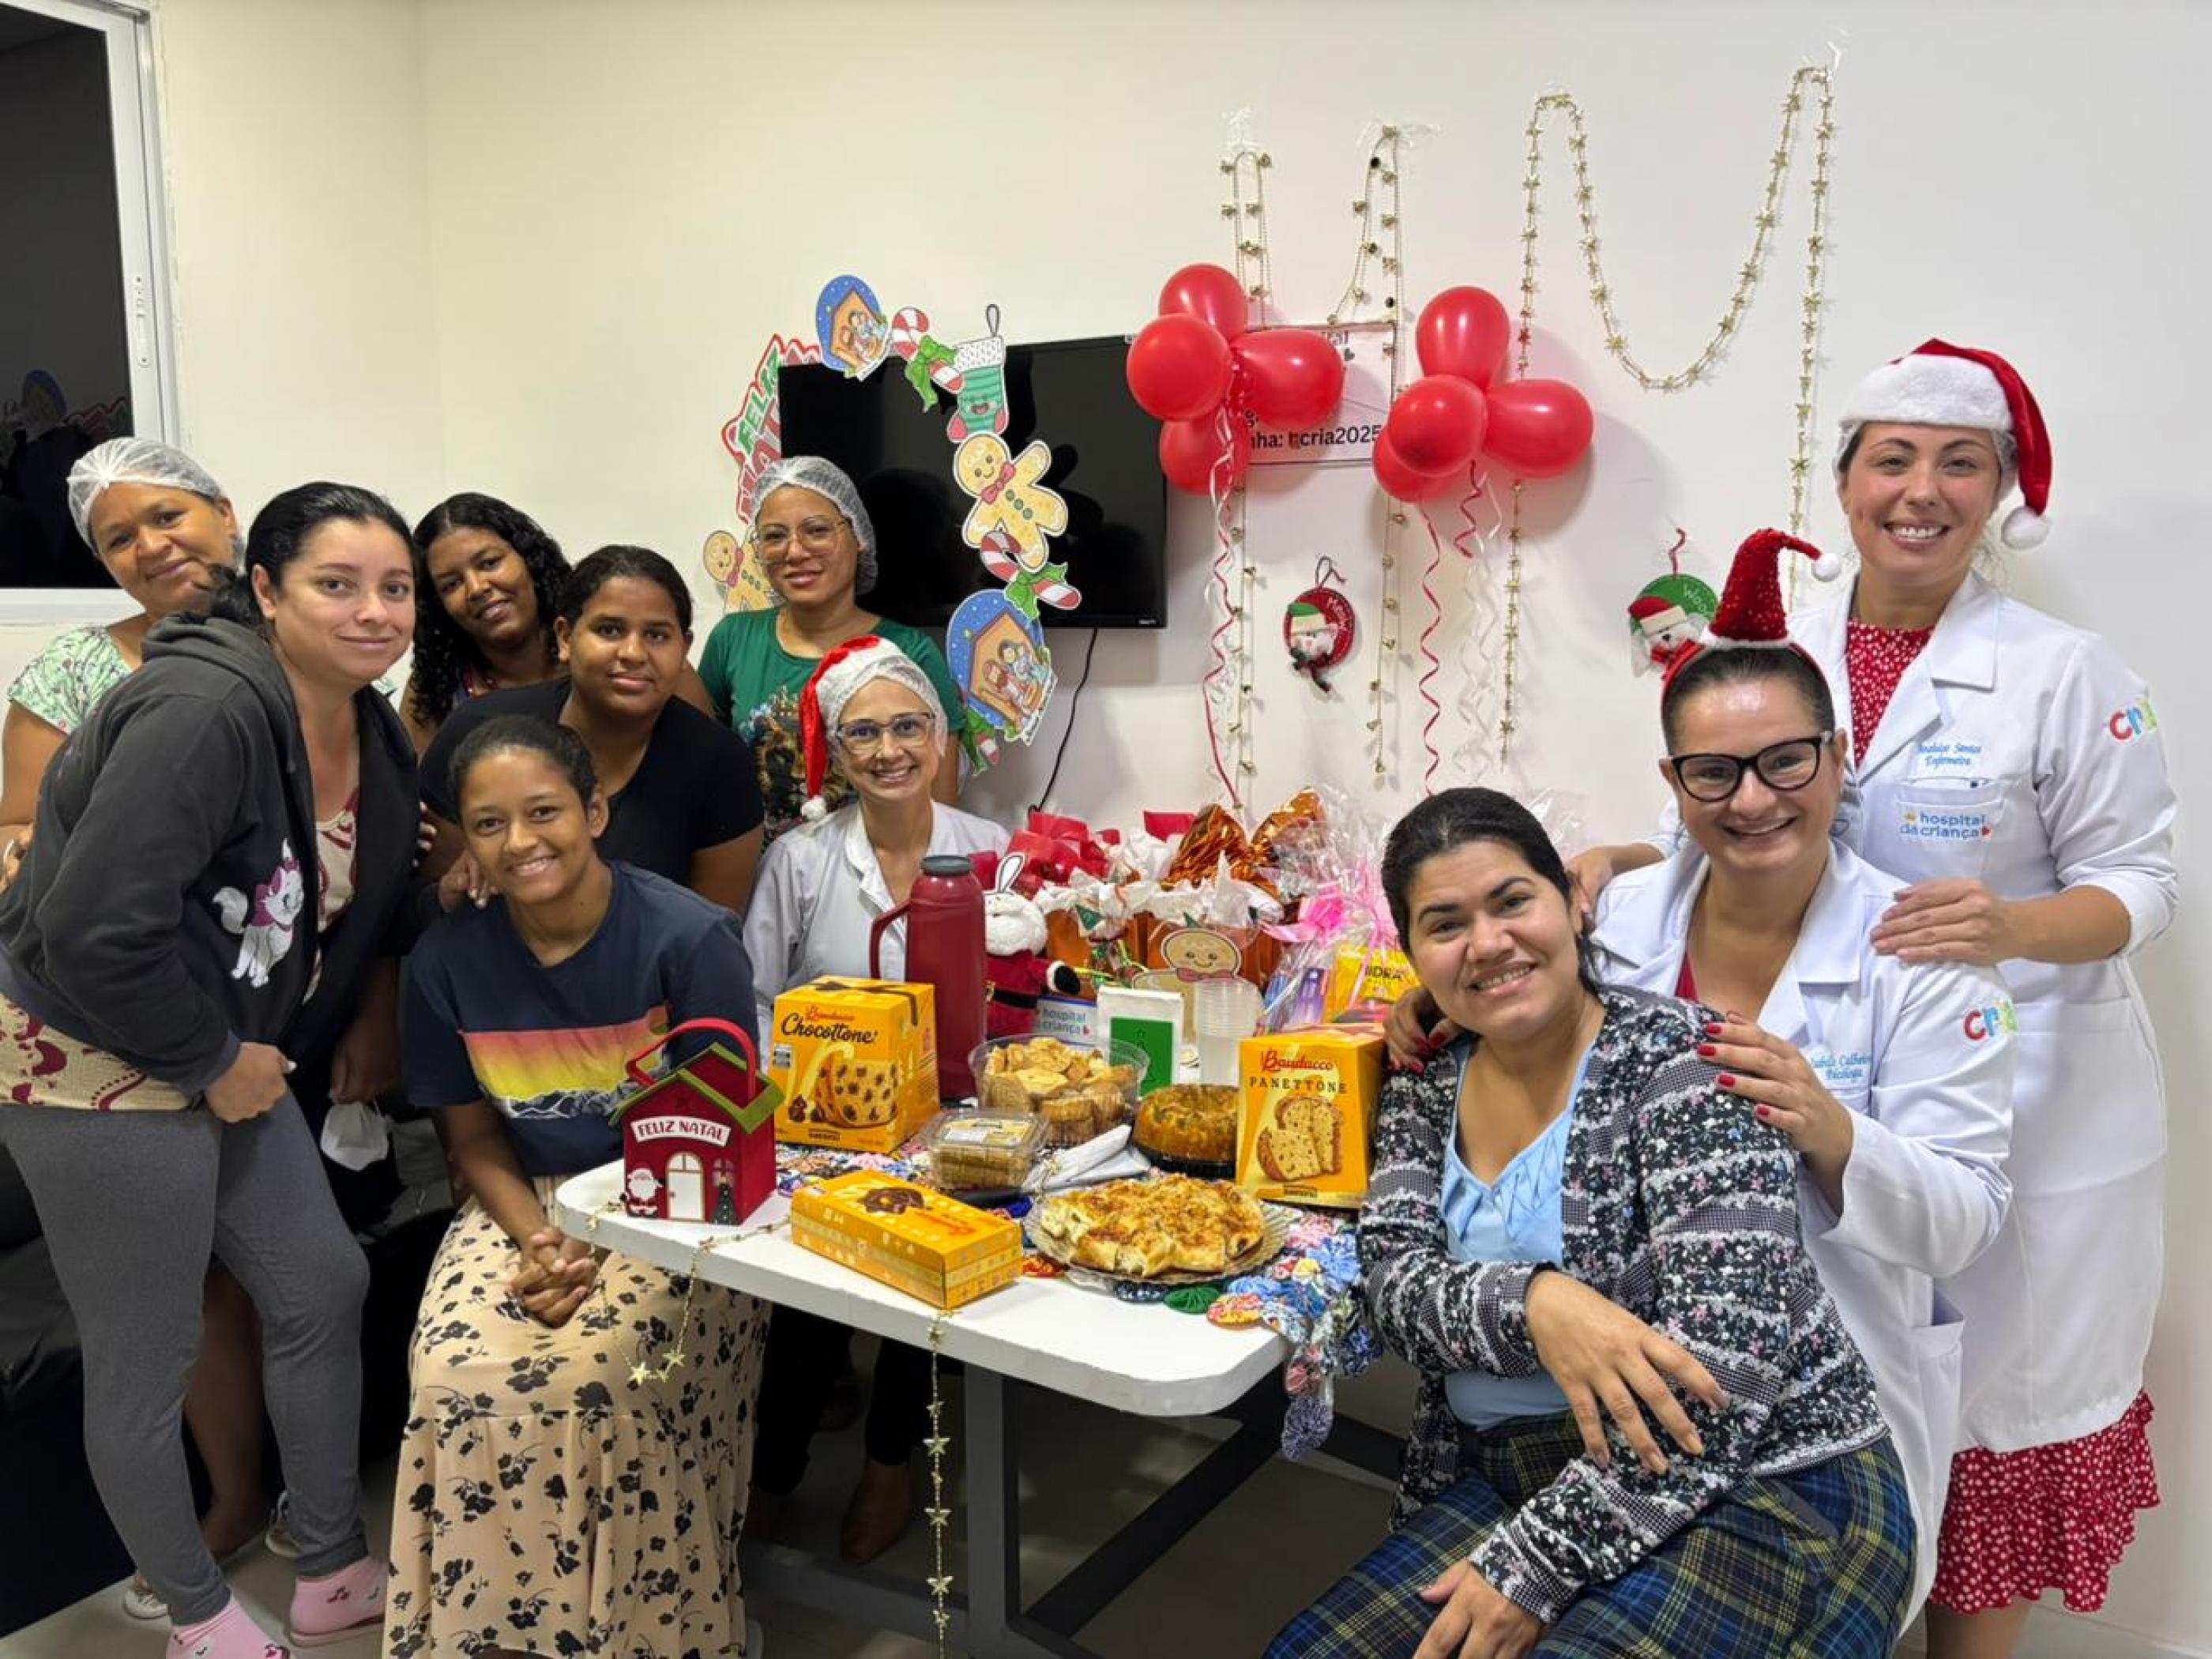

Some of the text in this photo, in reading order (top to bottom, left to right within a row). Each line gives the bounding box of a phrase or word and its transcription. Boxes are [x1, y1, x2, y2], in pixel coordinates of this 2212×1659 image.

[1920, 813, 1984, 826] hospital
[1262, 1048, 1333, 1070] Bauducco
[1249, 1076, 1347, 1094] PANETTONE
[637, 1121, 723, 1141] FELIZ NATAL
